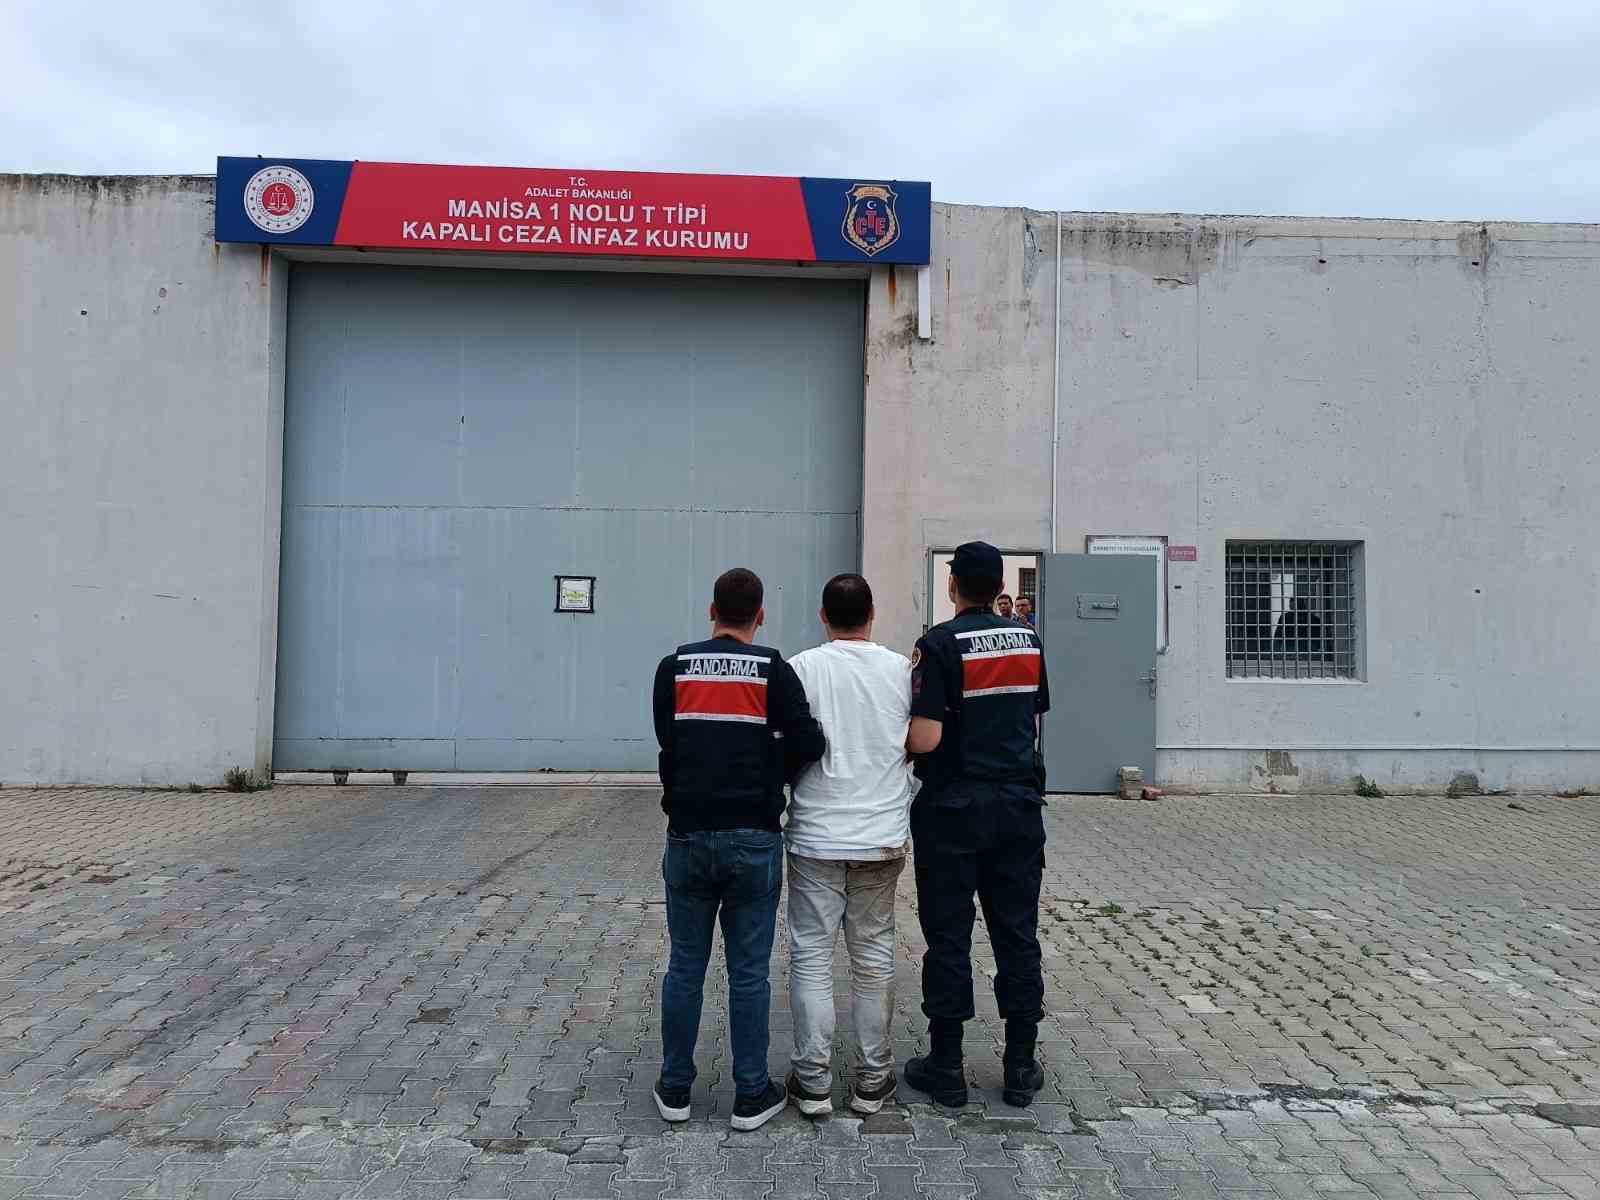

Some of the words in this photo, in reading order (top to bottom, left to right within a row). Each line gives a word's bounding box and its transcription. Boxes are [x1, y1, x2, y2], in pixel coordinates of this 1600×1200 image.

[569, 177, 588, 187] T.C.
[524, 188, 569, 198] ADALET
[572, 188, 632, 200] BAKANLIĞI
[448, 197, 542, 220] MANİSA
[550, 203, 560, 221] 1
[569, 203, 635, 223] NOLU
[642, 206, 656, 224] T
[663, 202, 707, 225] TİPİ
[402, 221, 491, 243] KAPALI
[498, 224, 563, 244] CEZA
[570, 223, 638, 247] İNFAZ
[646, 229, 748, 250] KURUMU
[968, 632, 1033, 653] JANDARMA
[685, 658, 760, 678] JANDARMA
